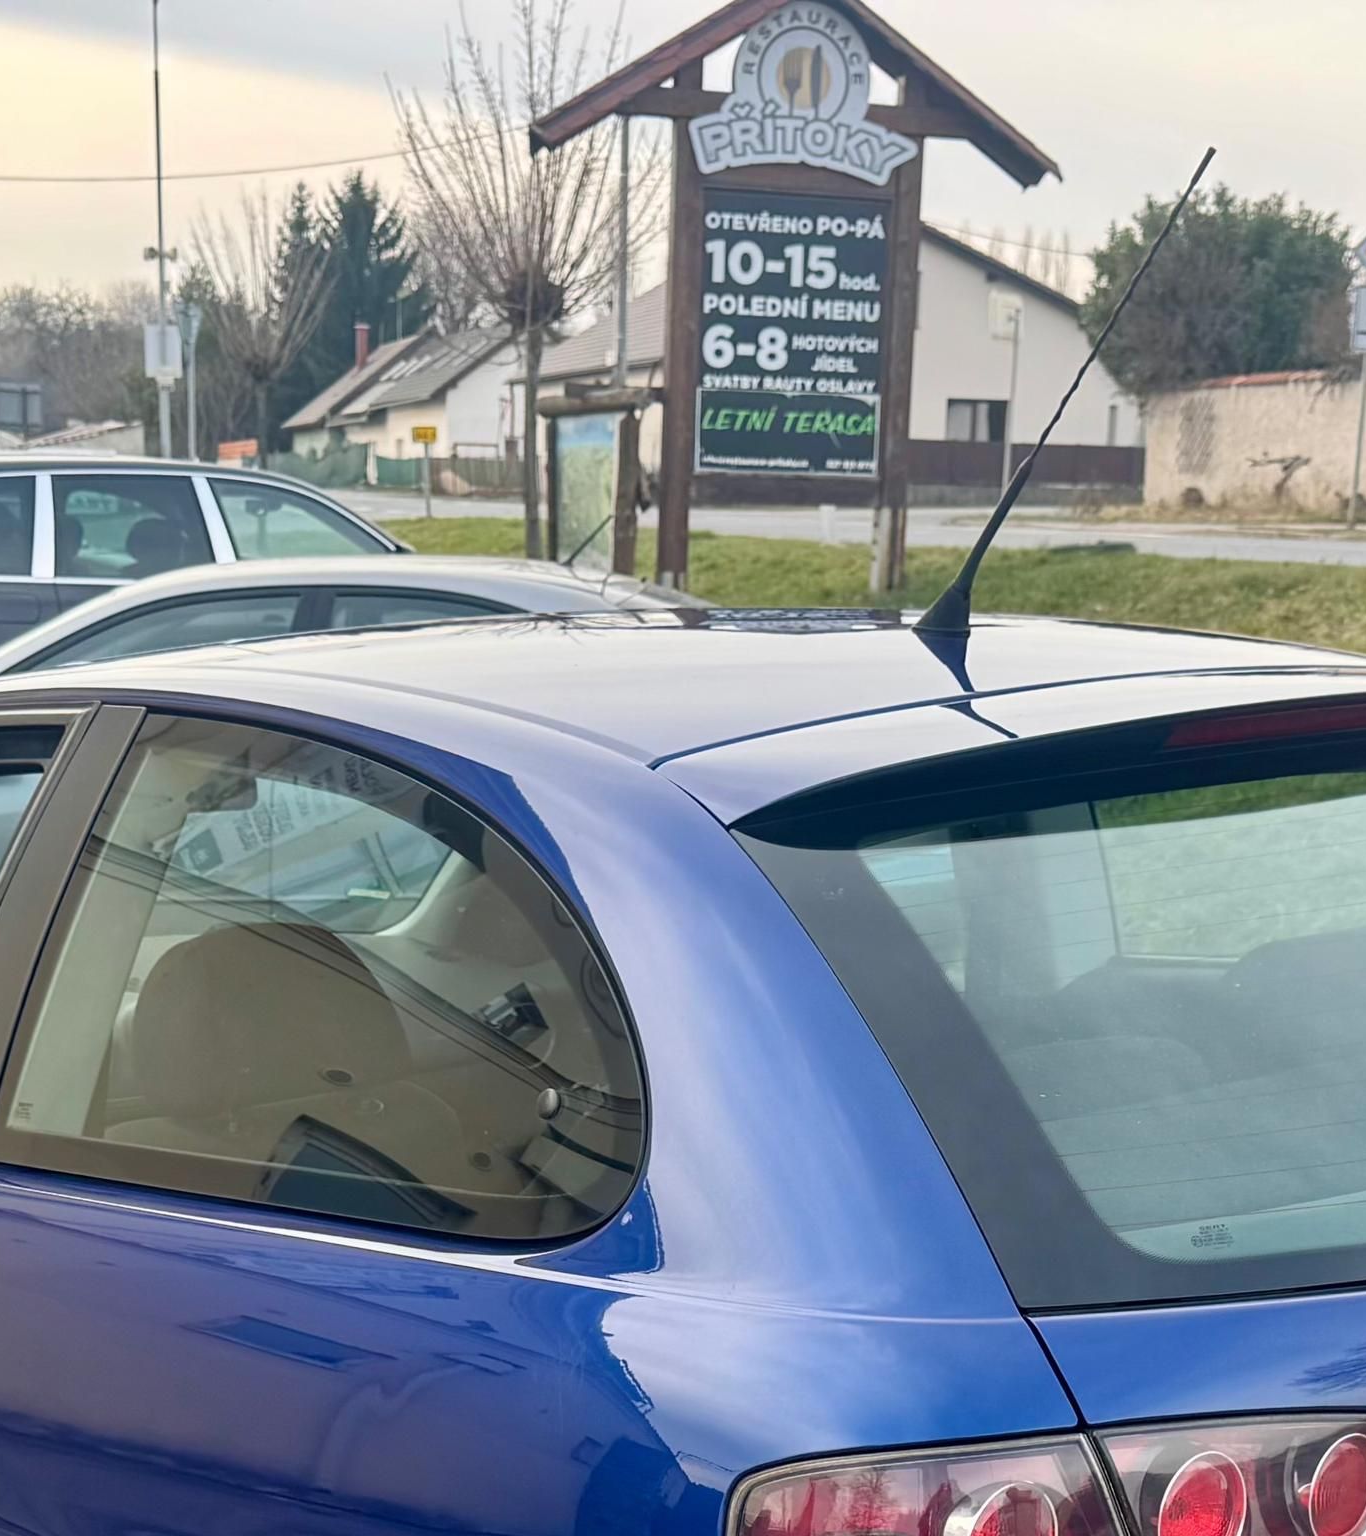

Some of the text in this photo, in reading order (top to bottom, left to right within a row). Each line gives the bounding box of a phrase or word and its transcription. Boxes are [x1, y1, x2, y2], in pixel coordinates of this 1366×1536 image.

[741, 9, 865, 86] RESTAURACE
[697, 99, 907, 177] PŘÍTOKY
[704, 210, 814, 236] OTEVŘENO
[704, 238, 881, 292] 10-15 hod.
[702, 292, 881, 323] POLEDNÍ MENU
[702, 323, 880, 372] 6-8 HOTOVÝCH
[810, 354, 859, 374] JÍDEL
[702, 373, 876, 394] SVATBY RAUTY OSLAVY
[701, 405, 876, 436] LETNÍ TERASA
